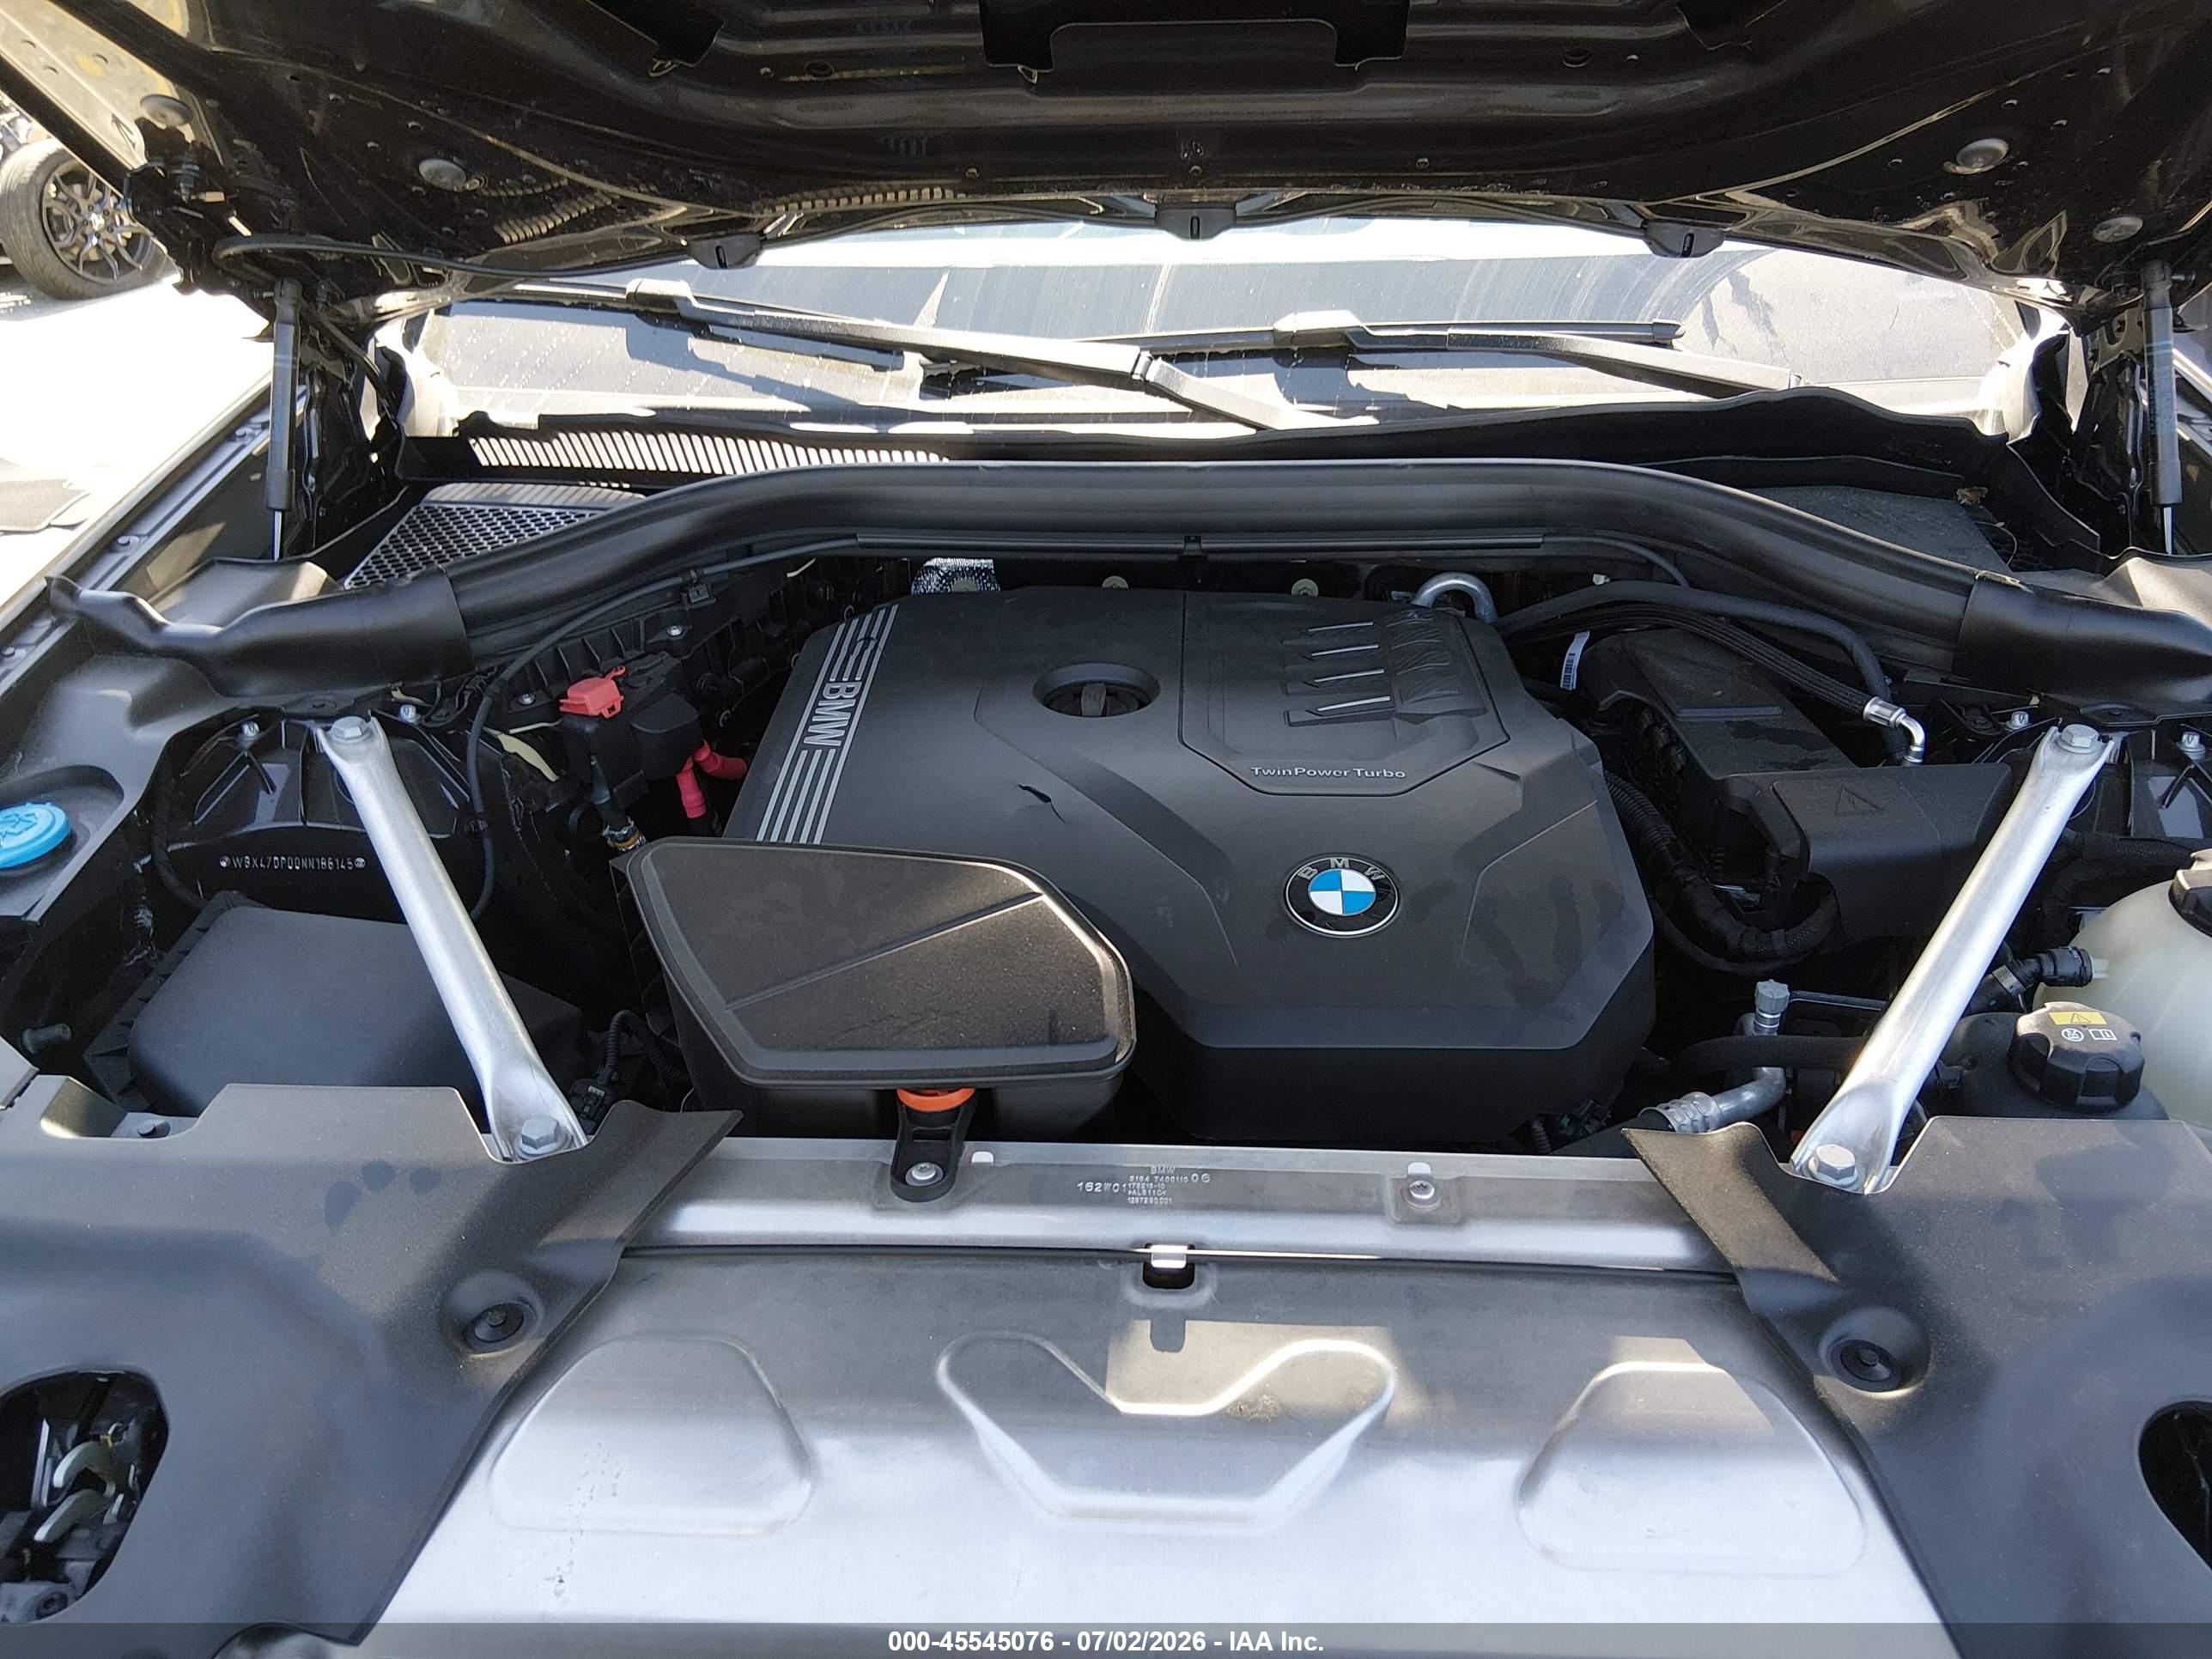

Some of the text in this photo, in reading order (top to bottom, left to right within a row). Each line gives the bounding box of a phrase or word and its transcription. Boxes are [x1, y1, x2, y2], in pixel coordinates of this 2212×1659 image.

[802, 681, 863, 747] BMW
[1250, 766, 1407, 779] TwinPower Turbo
[1297, 857, 1385, 881] BMW
[1151, 1164, 1176, 1175] BMW
